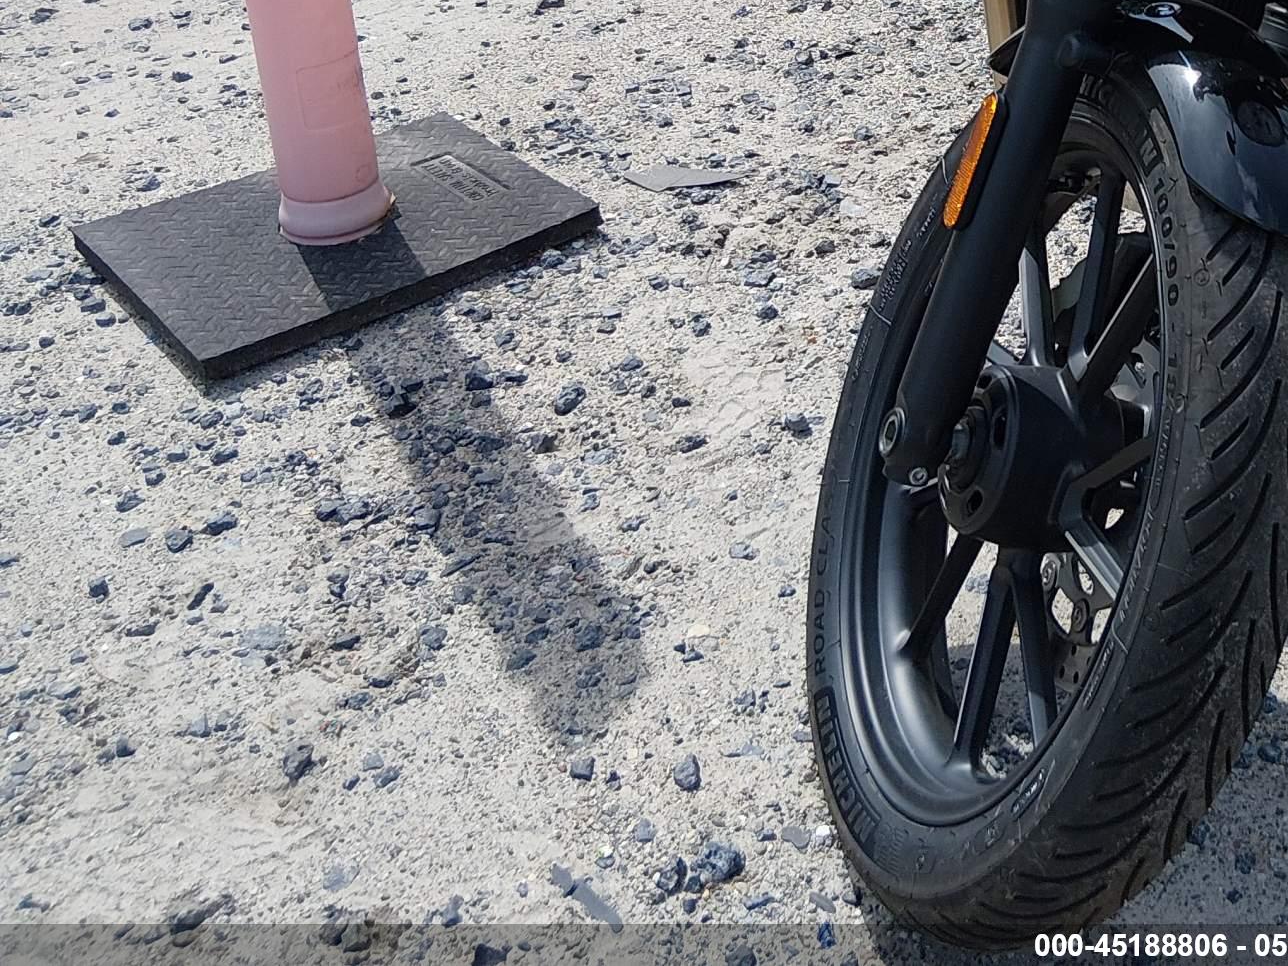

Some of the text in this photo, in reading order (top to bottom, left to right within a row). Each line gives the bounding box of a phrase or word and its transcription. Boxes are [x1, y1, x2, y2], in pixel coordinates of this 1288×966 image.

[1153, 177, 1180, 308] 100/90
[812, 590, 827, 676] ROAD
[814, 690, 879, 847] MICHELIN
